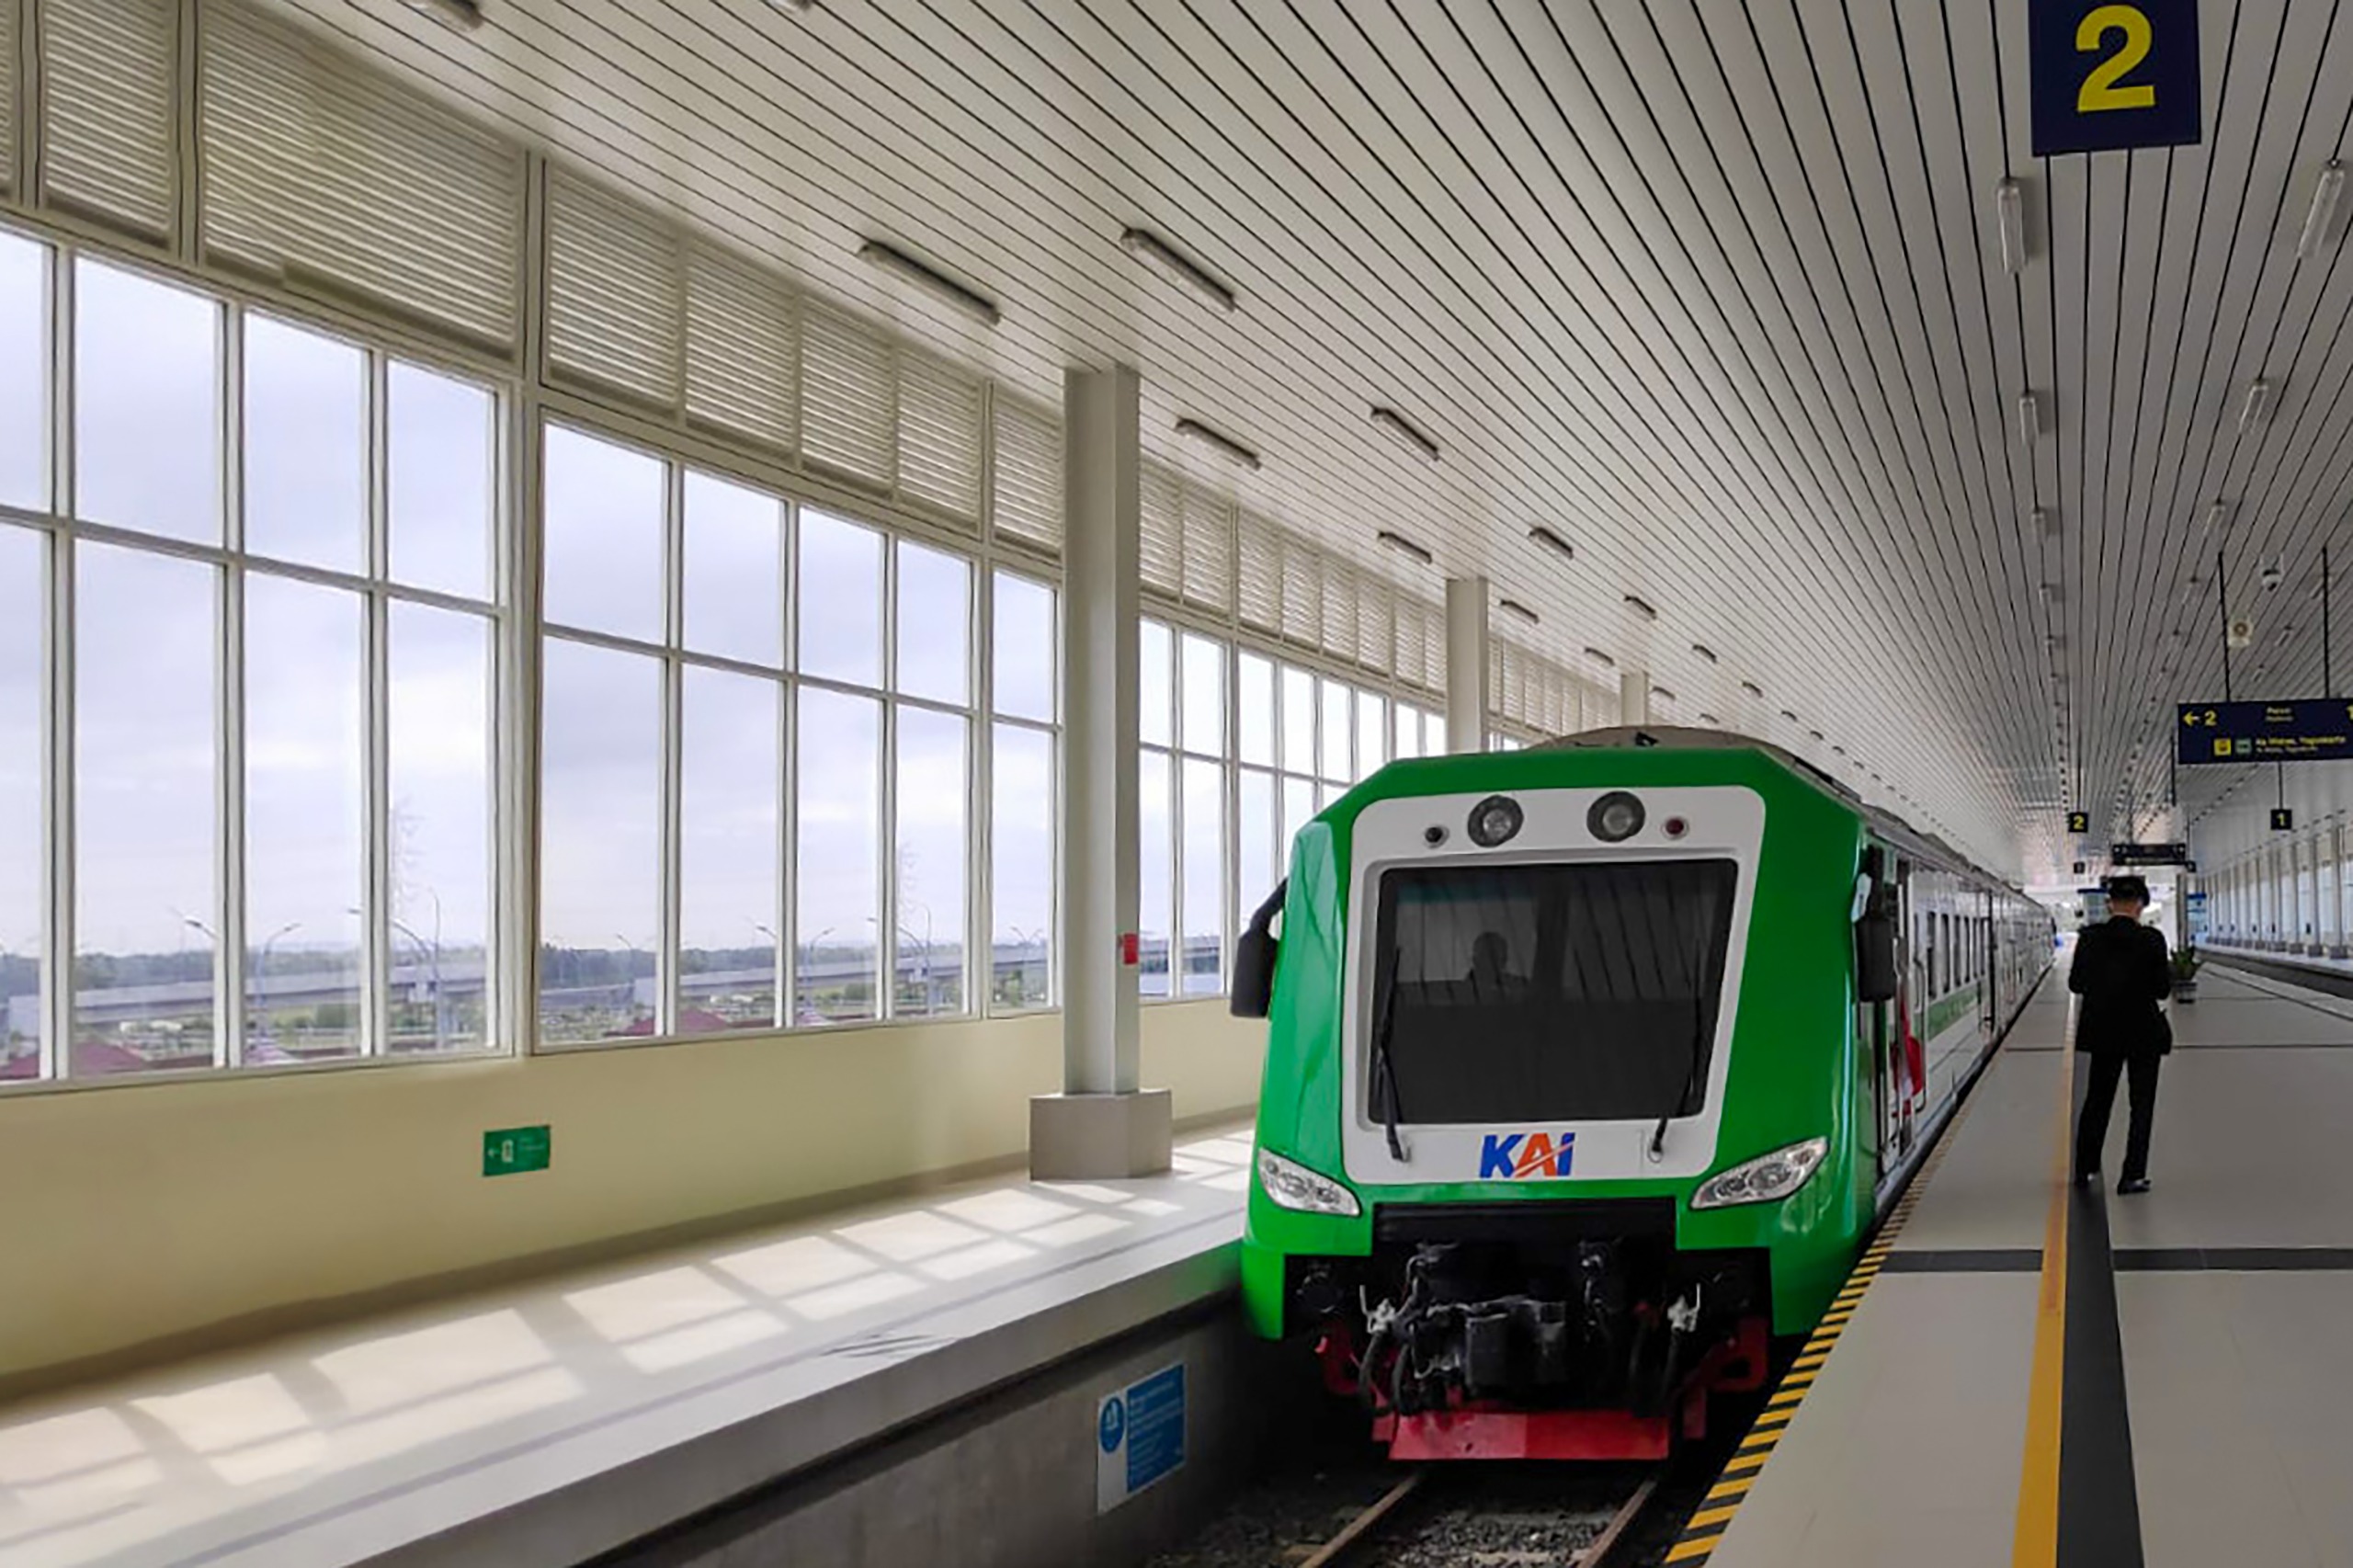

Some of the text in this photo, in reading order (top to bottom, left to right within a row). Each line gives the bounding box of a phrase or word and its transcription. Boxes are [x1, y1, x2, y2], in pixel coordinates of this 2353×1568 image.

[2075, 5, 2155, 112] 2
[2204, 710, 2217, 726] 2
[2073, 814, 2085, 829] 2
[2277, 813, 2285, 826] 1
[1480, 1132, 1575, 1178] KAI
